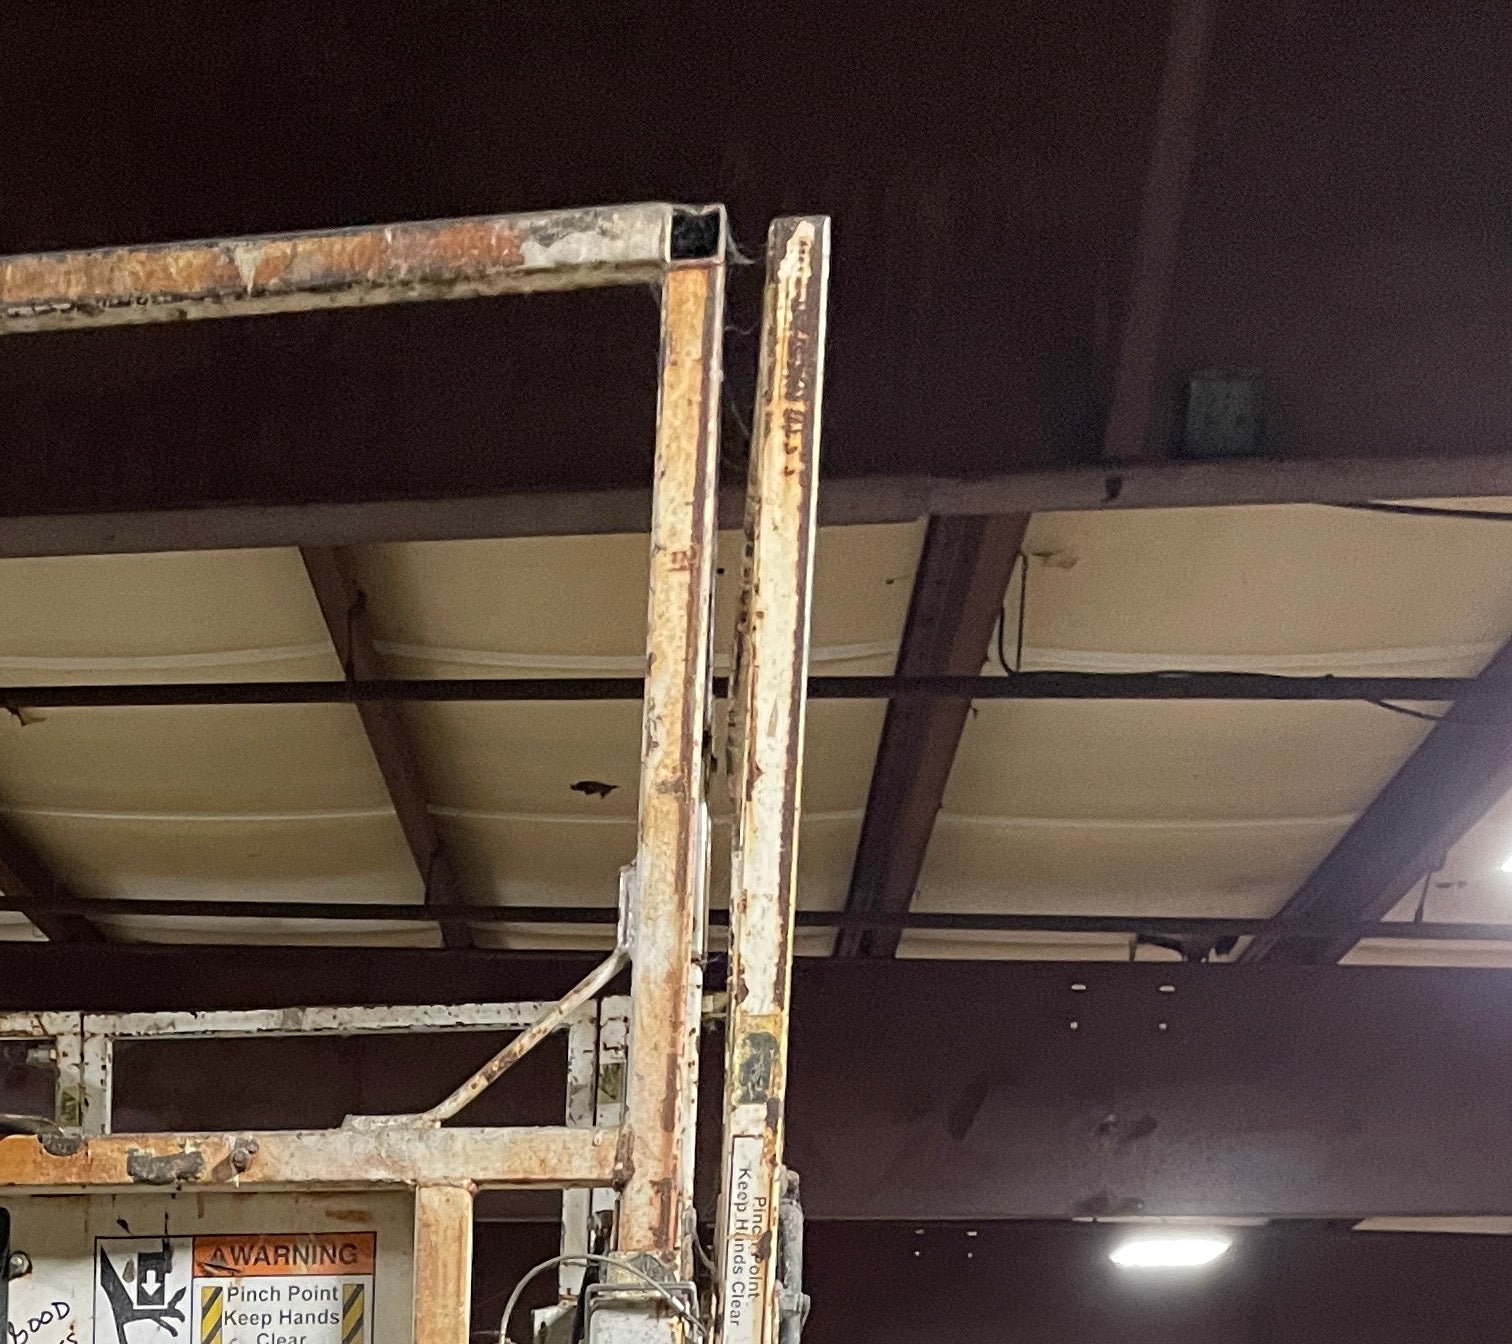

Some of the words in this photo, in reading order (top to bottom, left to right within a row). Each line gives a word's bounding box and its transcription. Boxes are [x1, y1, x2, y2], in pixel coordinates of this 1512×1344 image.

[734, 1168, 751, 1212] Keep
[232, 1242, 359, 1266] WARNING
[732, 1219, 749, 1275] Hnds
[227, 1286, 281, 1303] Pinch
[288, 1285, 339, 1301] Point
[730, 1282, 746, 1326] Clear
[224, 1310, 272, 1328] Keep
[279, 1309, 340, 1325] Hands
